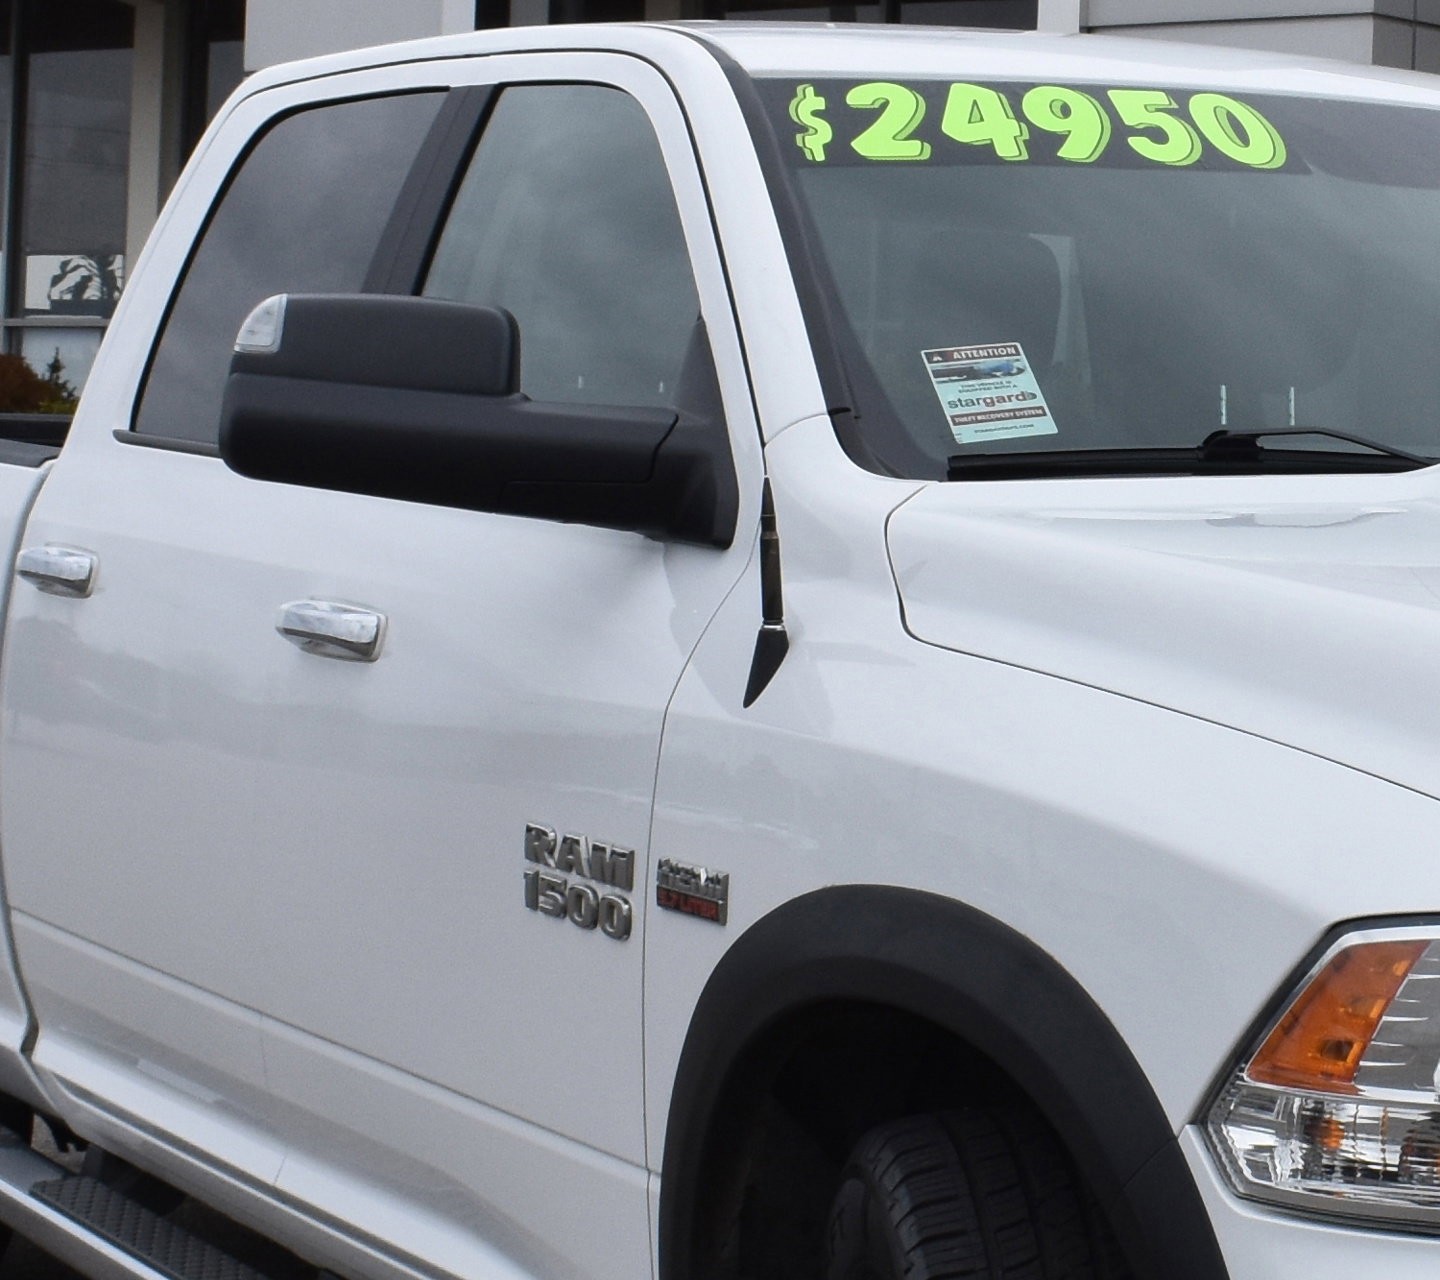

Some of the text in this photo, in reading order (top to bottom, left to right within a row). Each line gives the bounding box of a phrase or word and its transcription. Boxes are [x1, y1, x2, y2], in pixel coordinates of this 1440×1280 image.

[788, 81, 1287, 169] $24950
[952, 346, 1017, 360] ATTENTION
[524, 822, 635, 892] RAM
[523, 869, 632, 941] 1500
